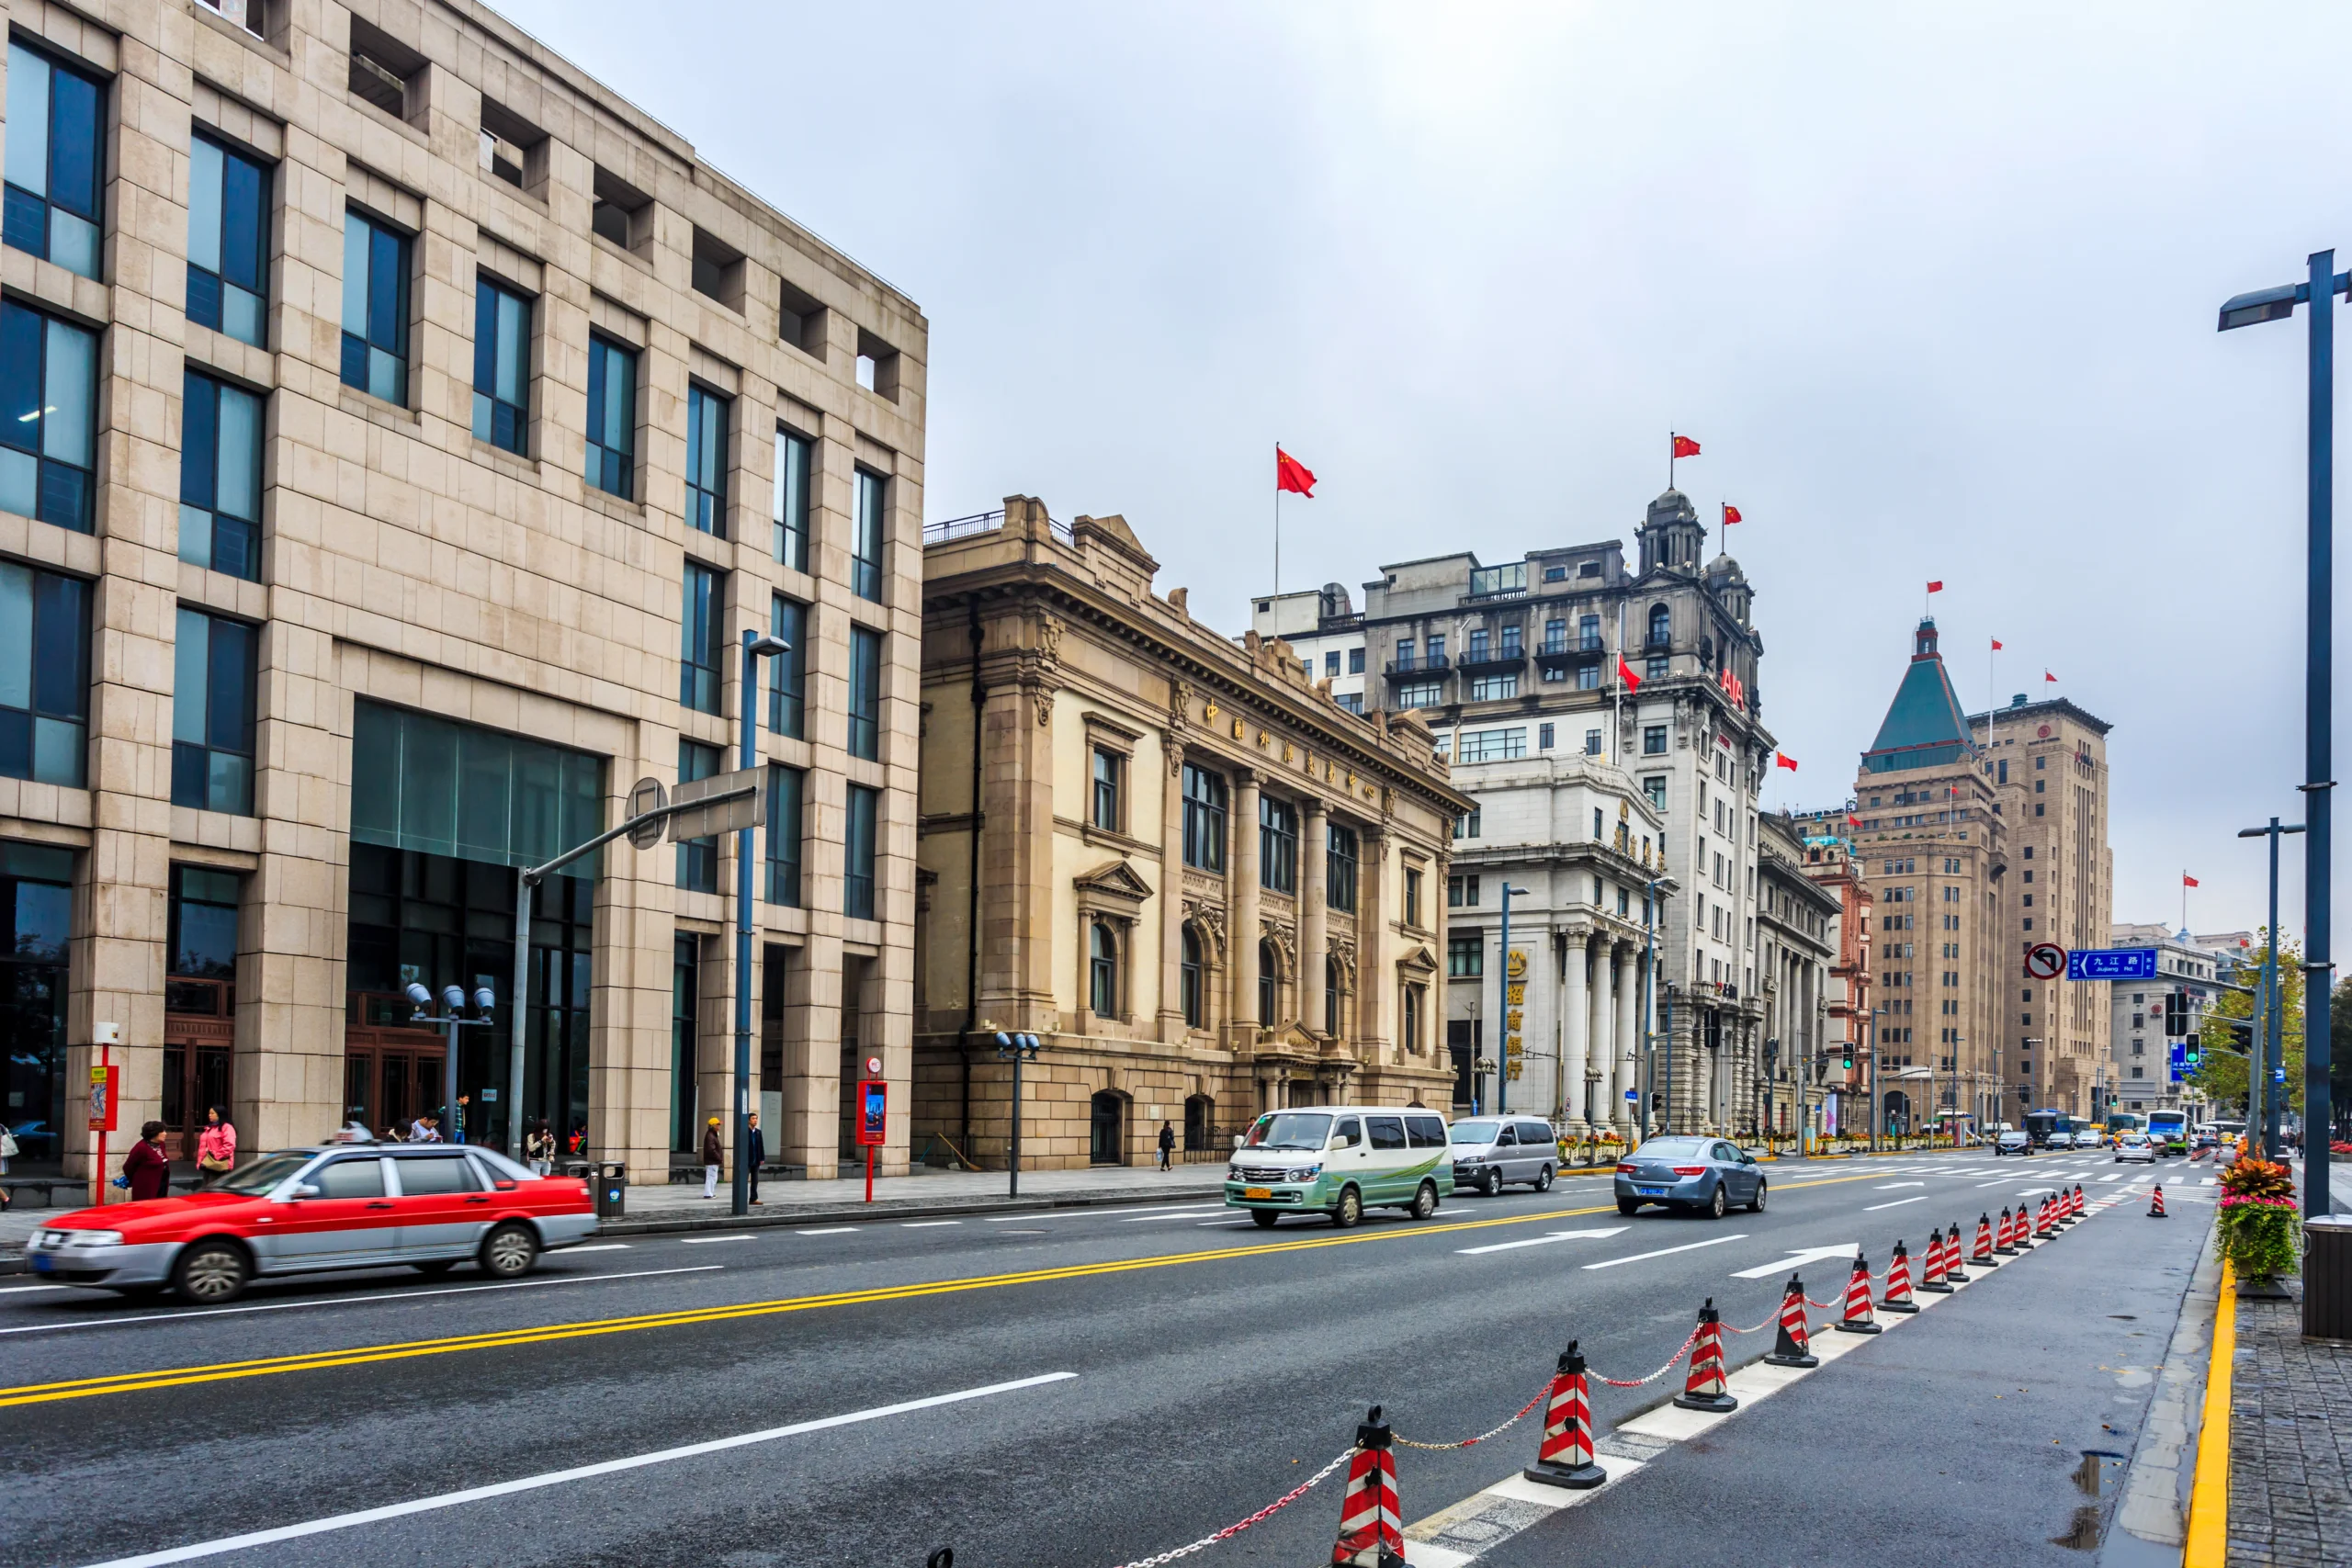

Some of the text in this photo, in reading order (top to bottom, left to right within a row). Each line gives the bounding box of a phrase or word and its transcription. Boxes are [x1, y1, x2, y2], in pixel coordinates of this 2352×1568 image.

[1721, 669, 1745, 712] AIA
[2093, 956, 2138, 965] 九江路
